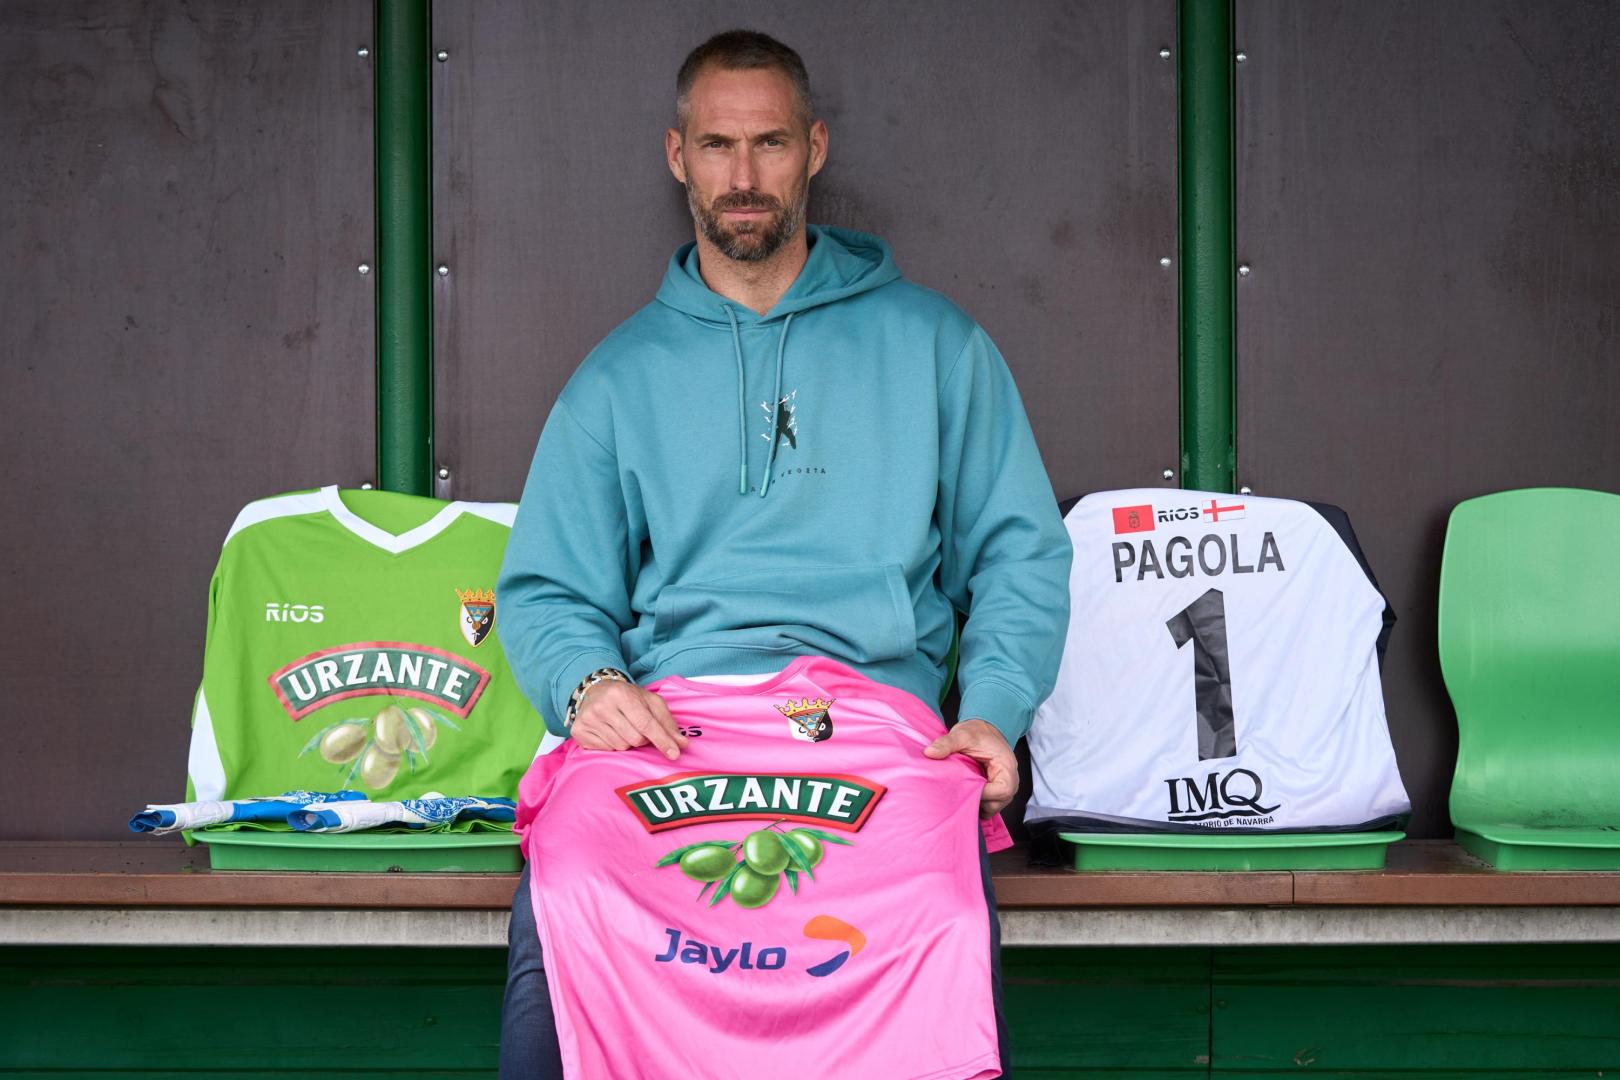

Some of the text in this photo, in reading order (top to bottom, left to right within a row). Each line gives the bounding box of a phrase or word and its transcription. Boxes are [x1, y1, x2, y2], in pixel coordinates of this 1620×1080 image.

[1111, 531, 1285, 583] PAGOLA
[288, 652, 471, 702] URZANTE
[1166, 587, 1238, 761] 1
[640, 777, 861, 818] URZANTE
[1164, 768, 1282, 815] IMQ
[1223, 818, 1235, 827] DE
[1236, 815, 1275, 826] NAVARRA
[655, 928, 786, 974] Jaylo
